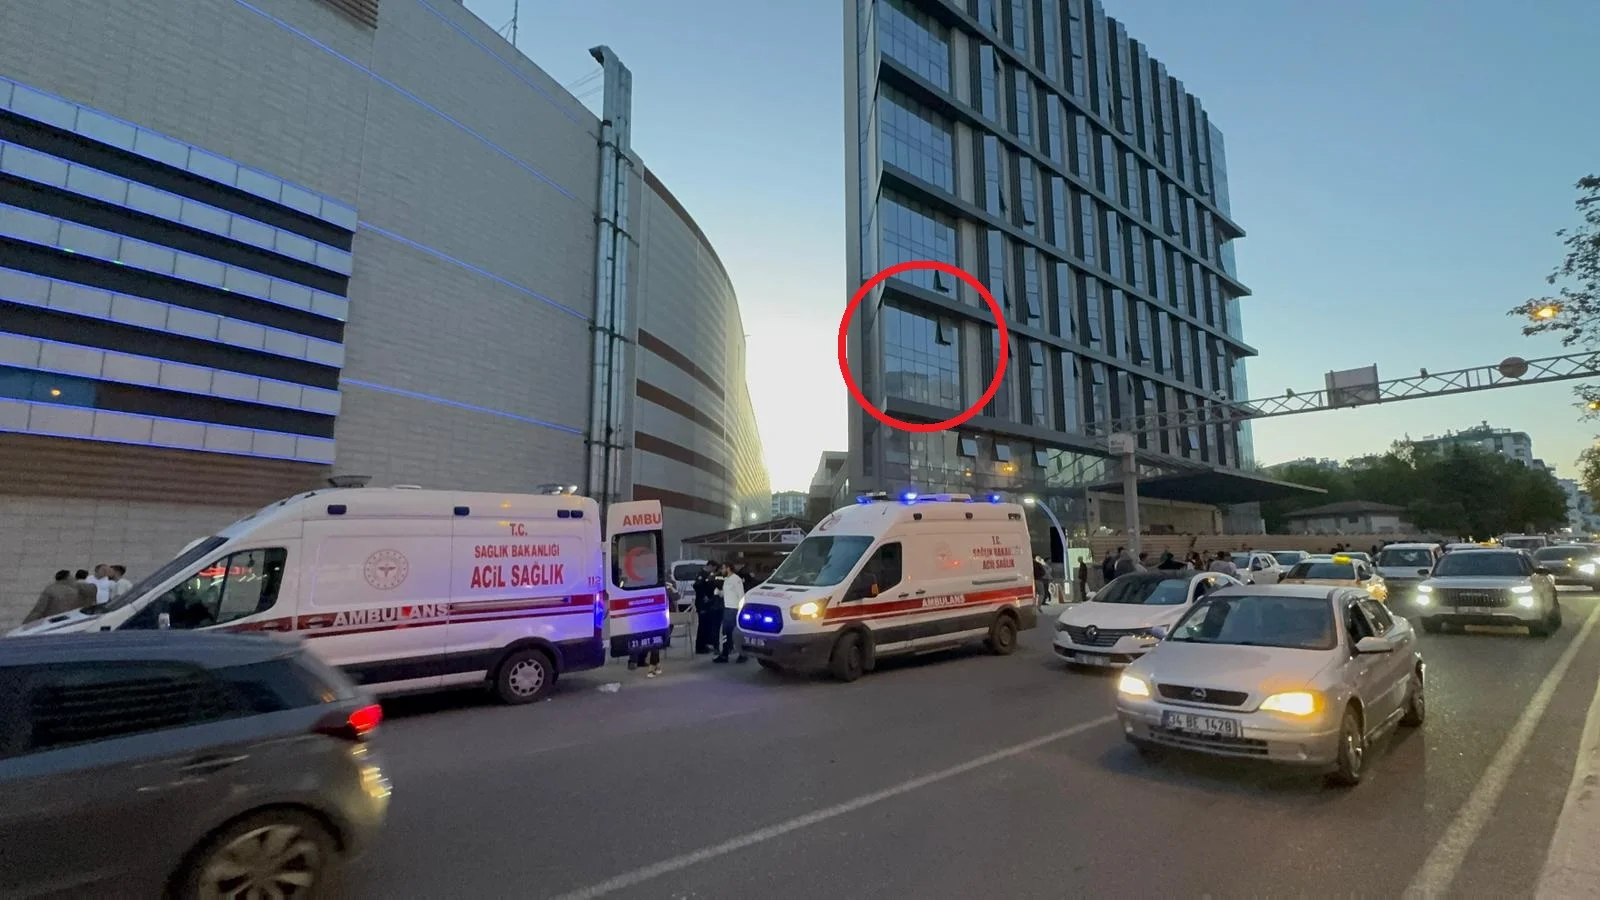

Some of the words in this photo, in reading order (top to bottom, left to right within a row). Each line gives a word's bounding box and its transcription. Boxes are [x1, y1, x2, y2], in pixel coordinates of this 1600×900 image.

[509, 523, 528, 536] T.C.
[511, 562, 565, 587] SAĞLIK
[921, 594, 966, 608] AMBULANS
[332, 603, 449, 627] AMBULANS
[1168, 714, 1182, 727] 34
